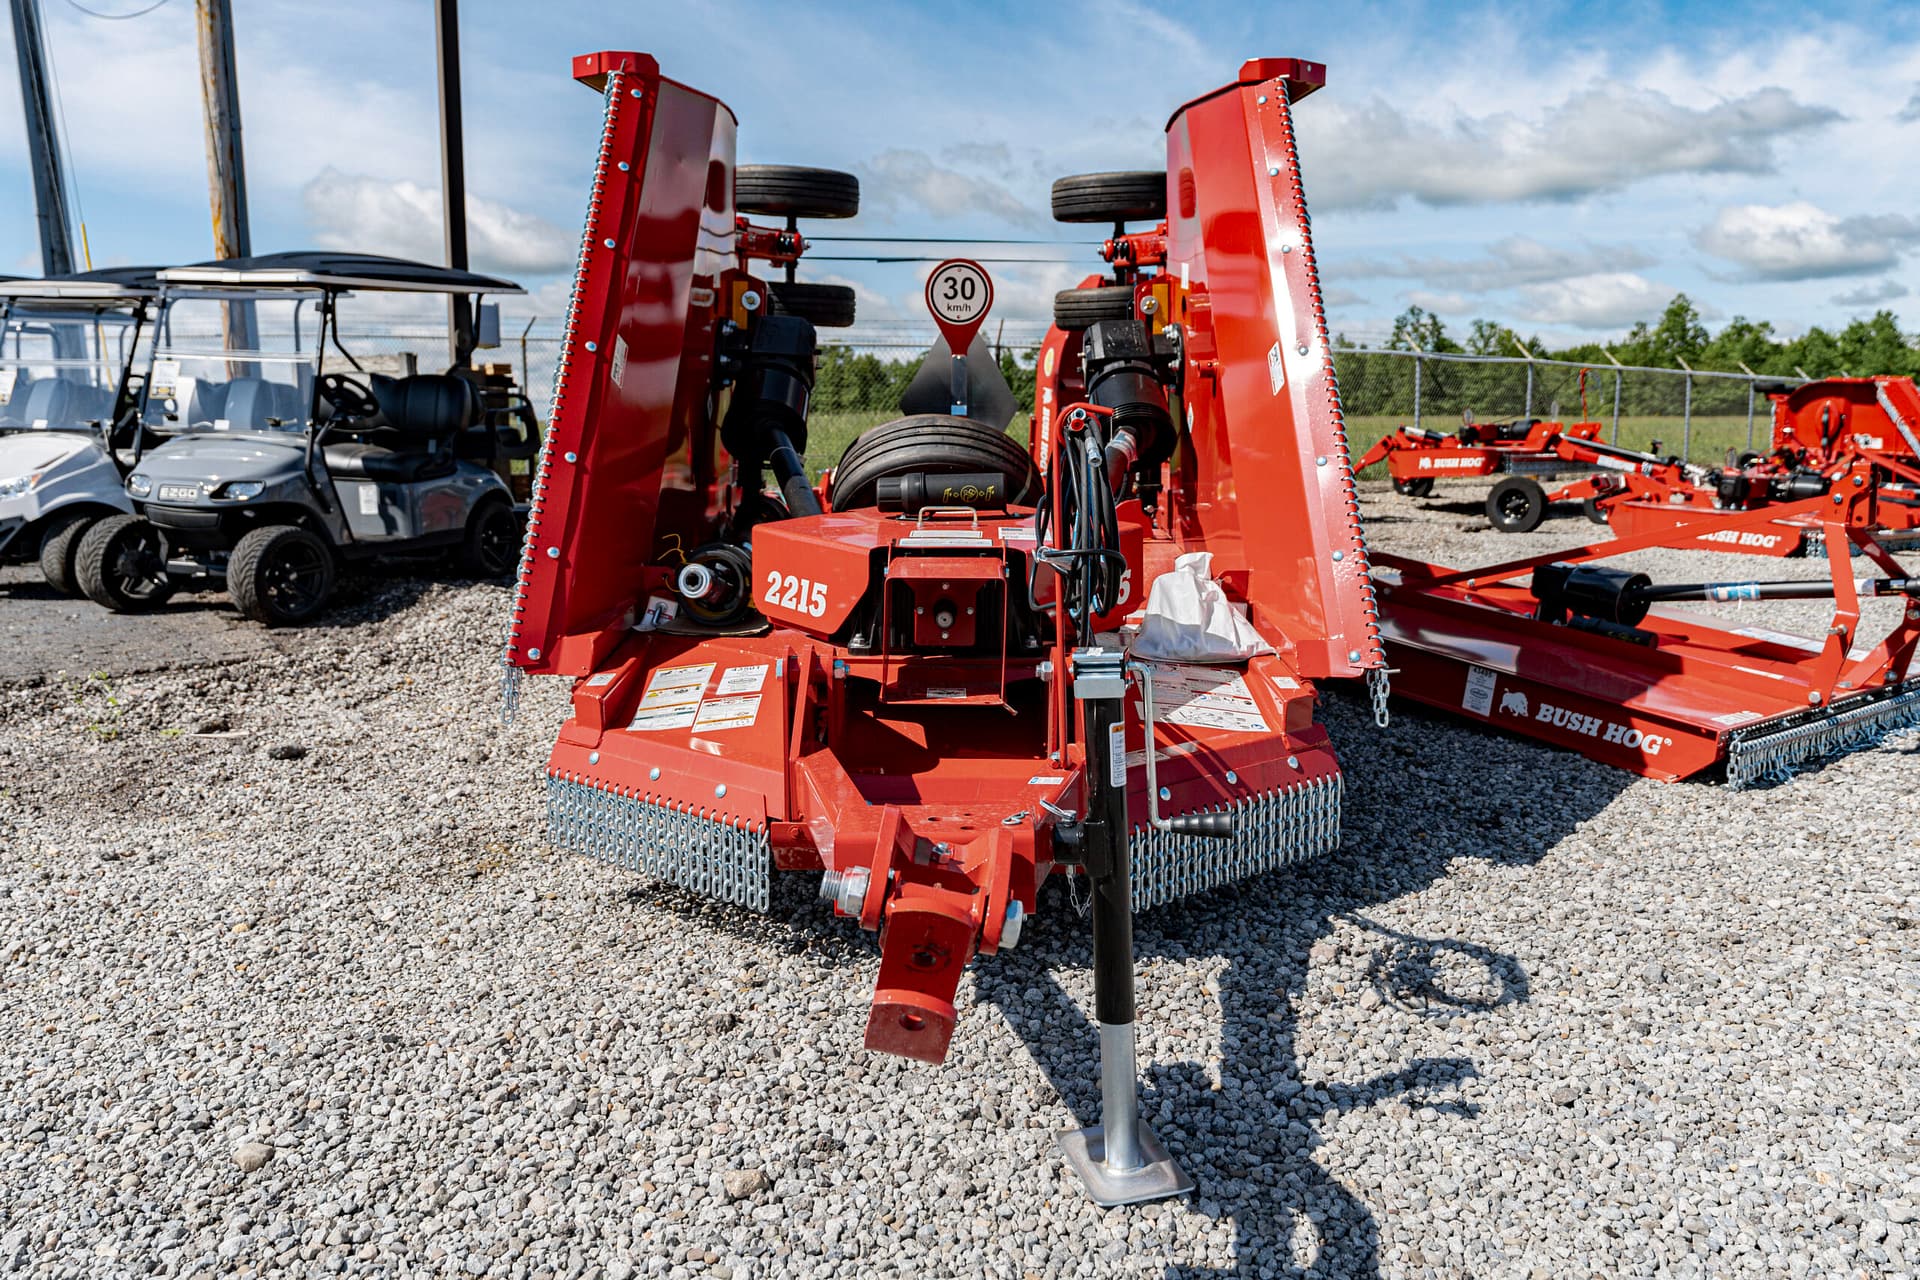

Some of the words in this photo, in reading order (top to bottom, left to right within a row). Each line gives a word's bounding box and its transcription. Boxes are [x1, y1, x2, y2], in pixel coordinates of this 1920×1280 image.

[943, 276, 976, 300] 30
[946, 303, 972, 312] km/h
[1434, 457, 1460, 468] BUSH
[764, 570, 828, 618] 2215
[1535, 703, 1603, 737] BUSH
